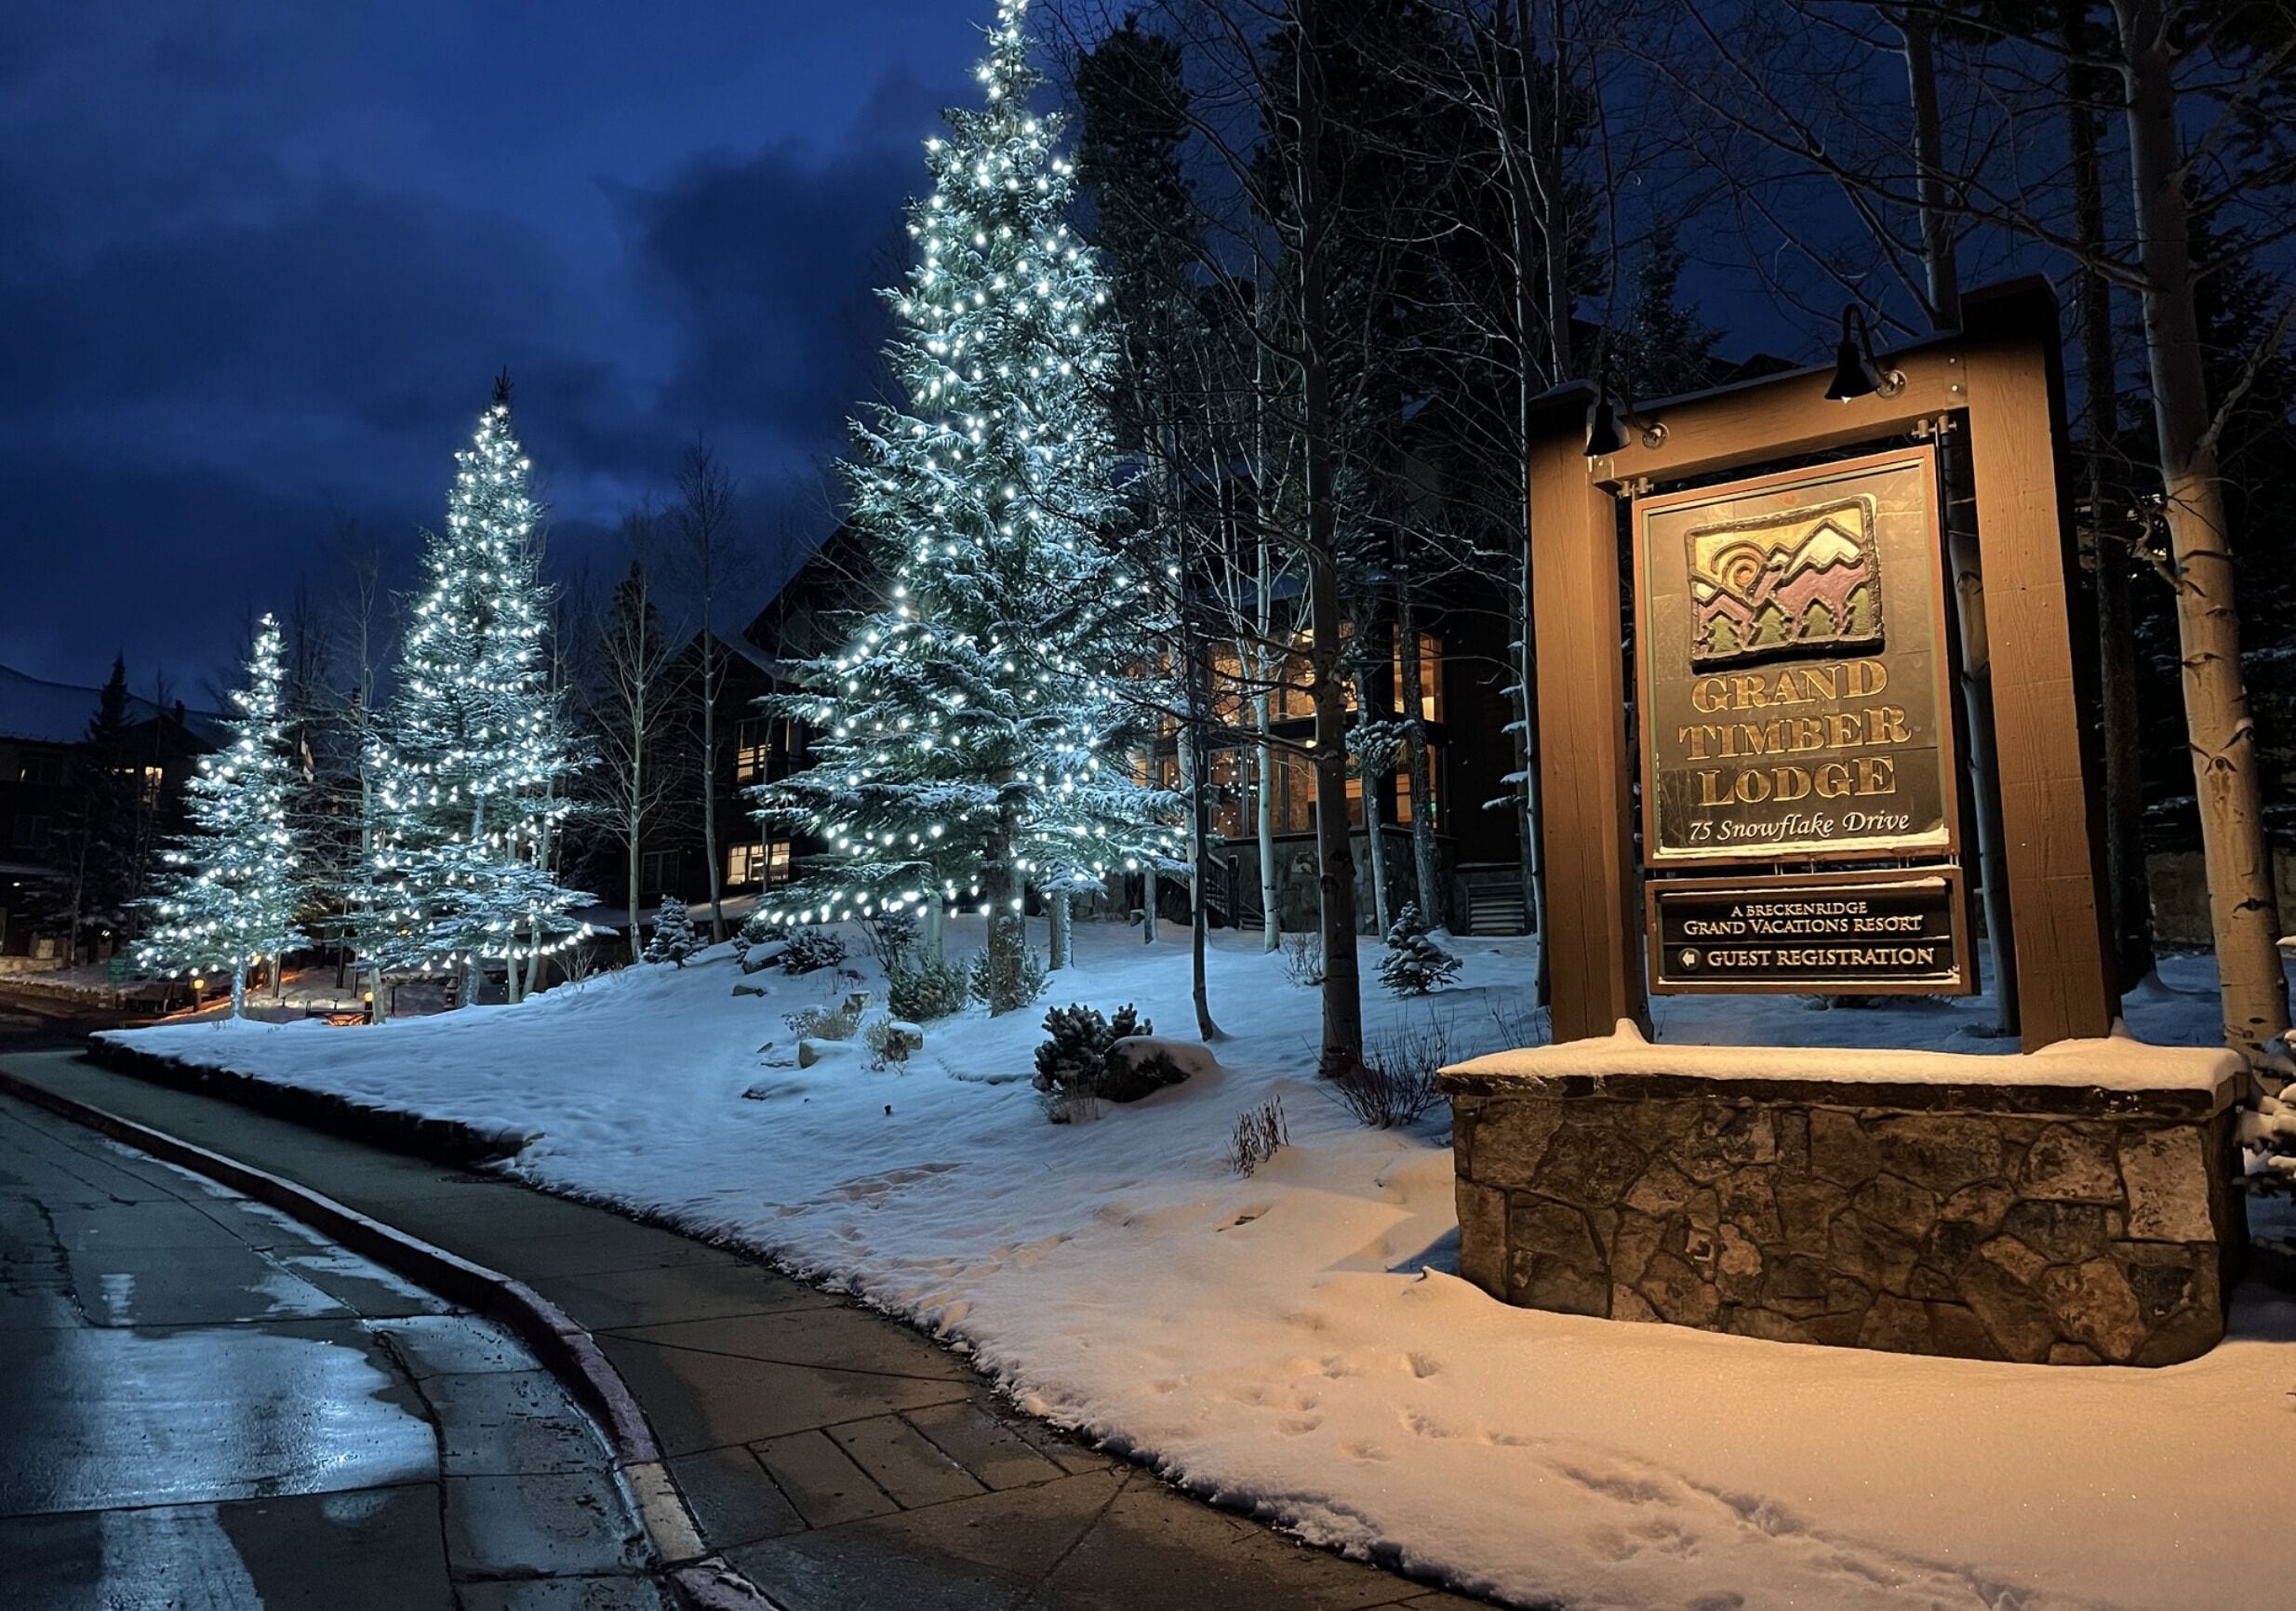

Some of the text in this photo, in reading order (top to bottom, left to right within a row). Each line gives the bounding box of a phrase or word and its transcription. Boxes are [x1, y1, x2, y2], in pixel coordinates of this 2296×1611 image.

[1691, 659, 1888, 713] GRAND
[1678, 707, 1912, 760] TIMBER
[1697, 755, 1896, 806] LODGE
[1689, 810, 1909, 842] 75 Snowflake Drive
[1683, 914, 1923, 936] GRAND VACATIONS RESORT
[1731, 901, 1868, 917] A BRECKENRIDGE
[1707, 947, 1935, 966] GUEST REGISTRATION
